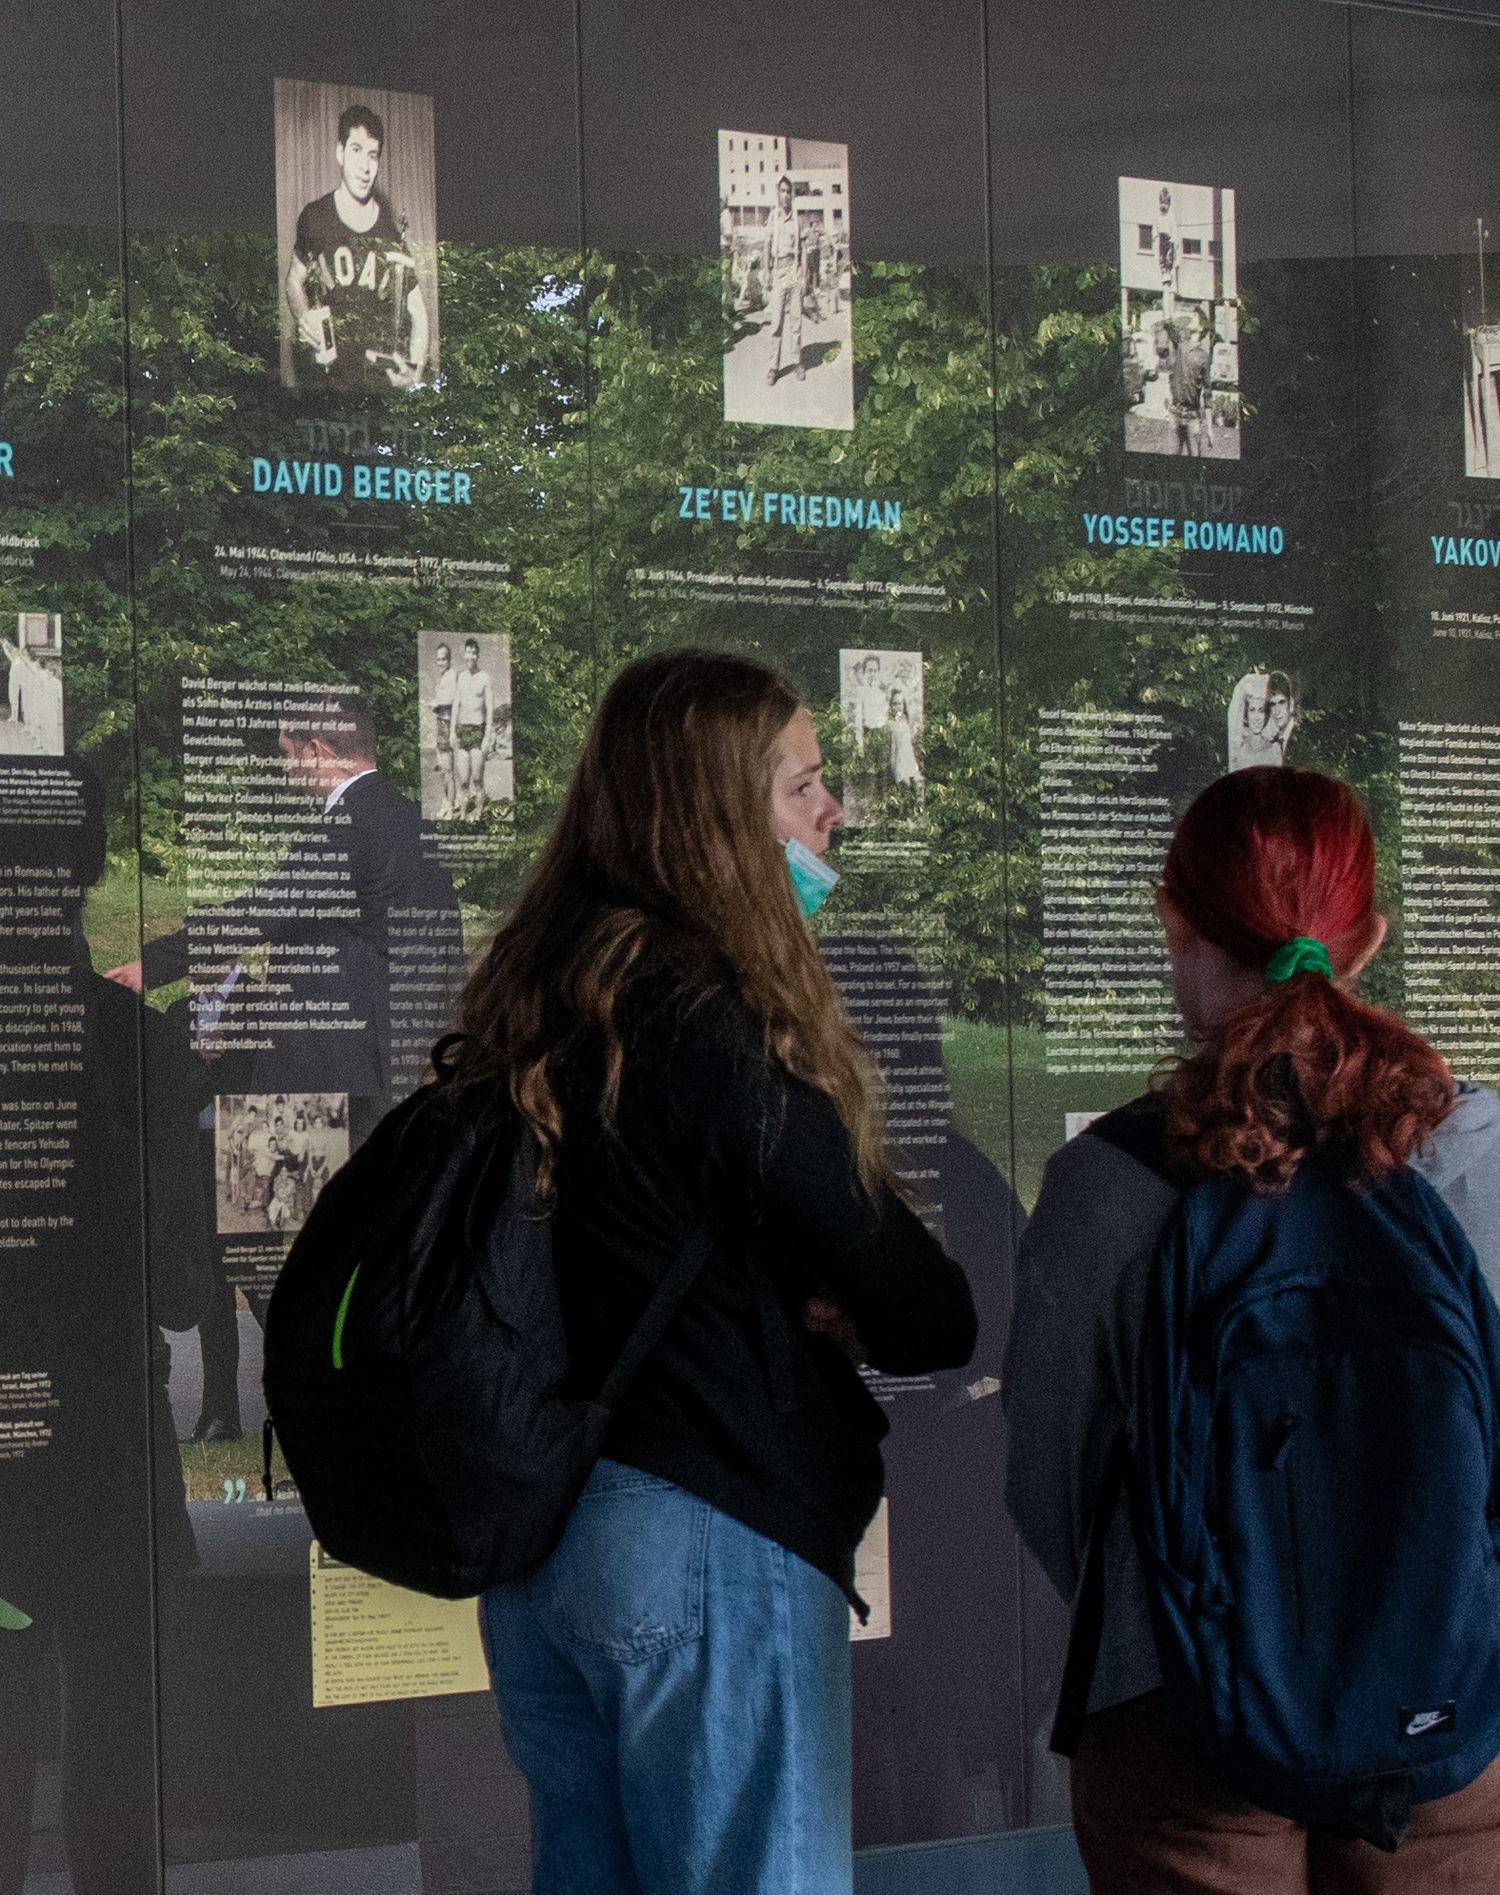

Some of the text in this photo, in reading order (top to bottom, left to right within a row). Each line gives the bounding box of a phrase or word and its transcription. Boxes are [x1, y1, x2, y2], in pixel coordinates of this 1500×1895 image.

[253, 457, 472, 504] DAVID BERGER
[679, 486, 902, 531] ZE'EV FRIEDMAN
[1083, 513, 1284, 555] YOSSEF ROMANO
